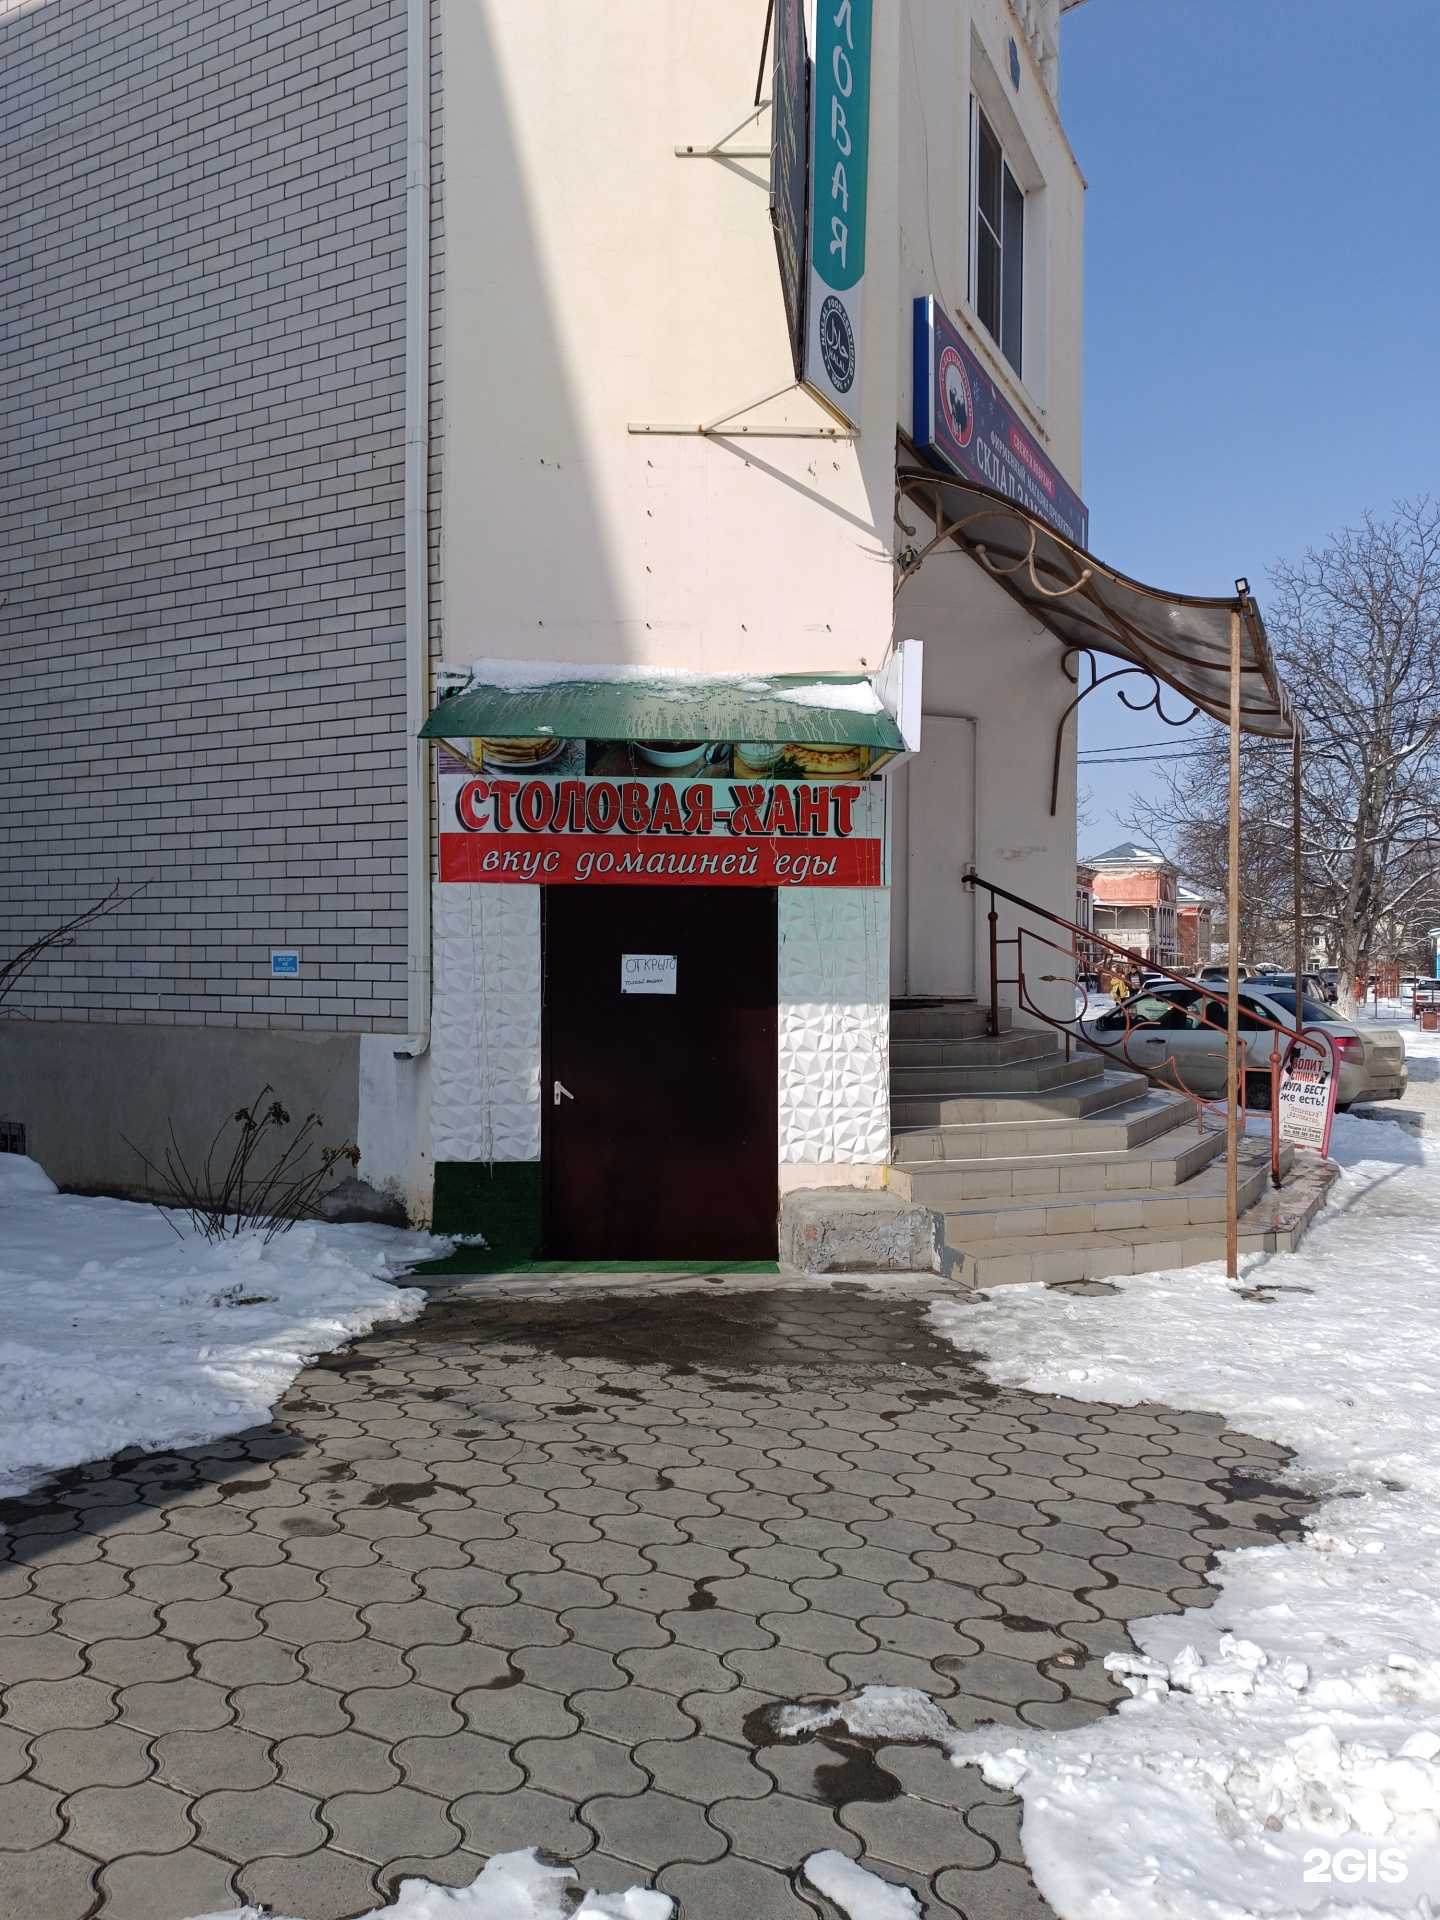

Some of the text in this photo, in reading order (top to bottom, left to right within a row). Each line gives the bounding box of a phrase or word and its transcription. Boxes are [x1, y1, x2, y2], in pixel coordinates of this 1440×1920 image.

[456, 779, 861, 837] СТОЛОВАЯ-ХАНТ
[482, 846, 838, 884] вкус домашней еды
[1282, 1081, 1327, 1096] НУГА БЕСТ
